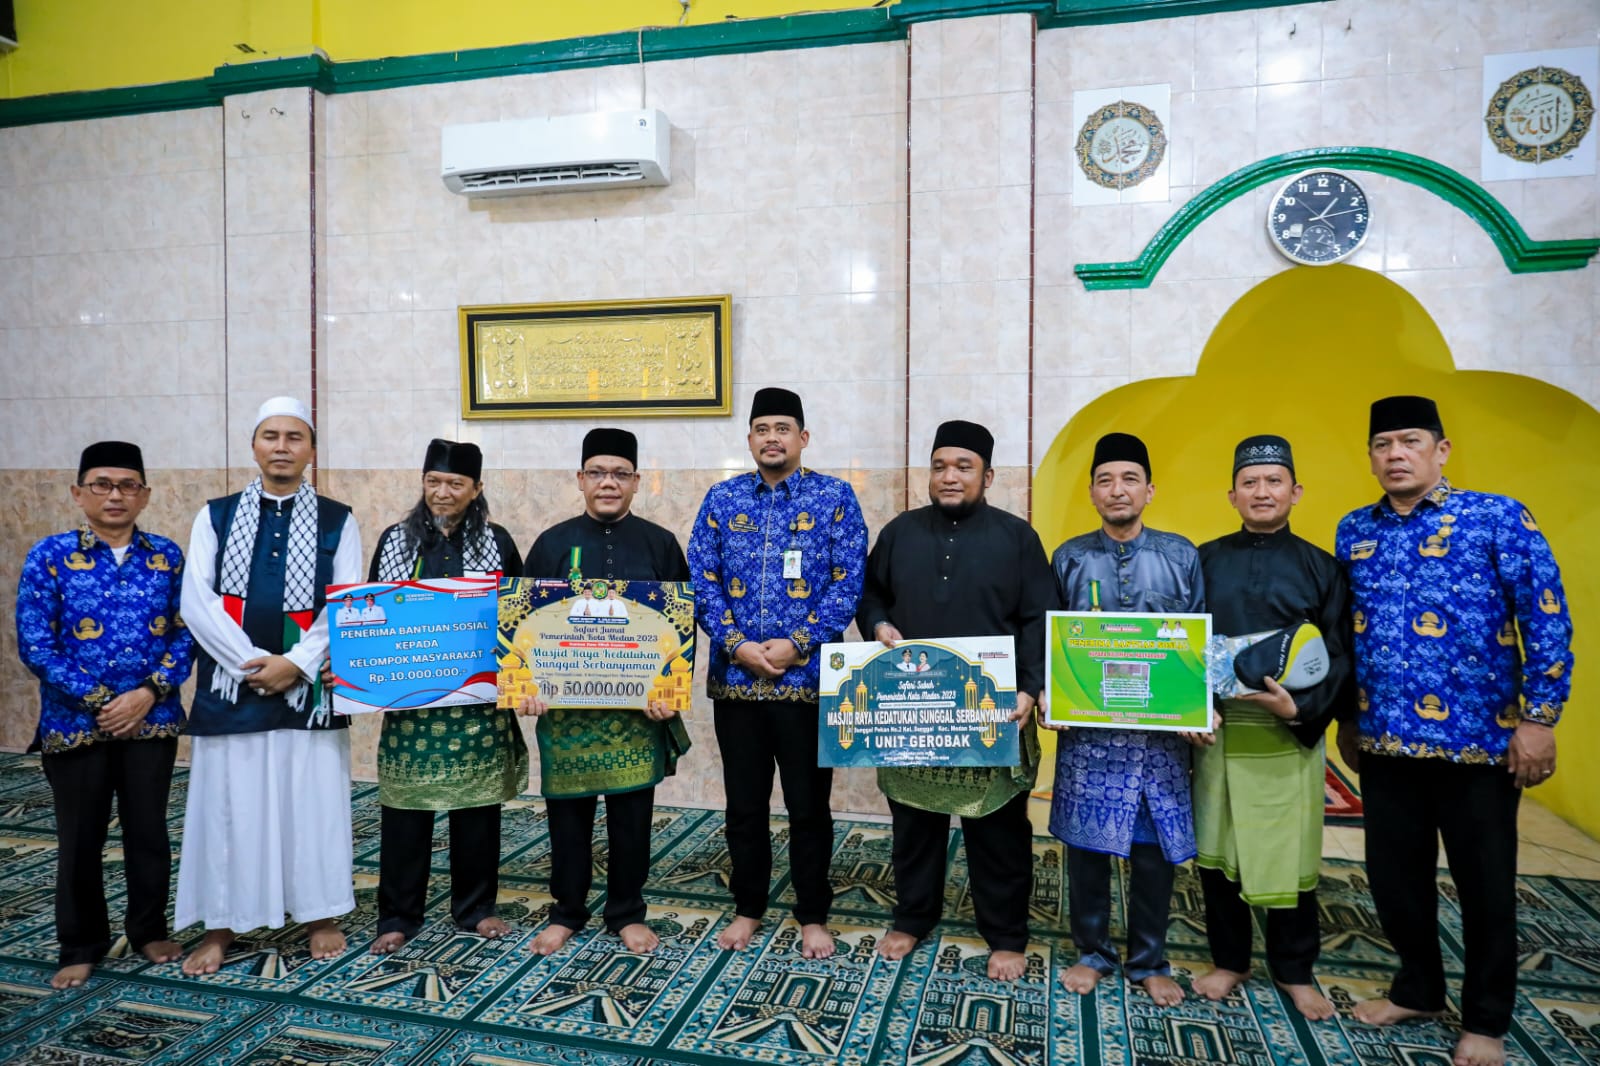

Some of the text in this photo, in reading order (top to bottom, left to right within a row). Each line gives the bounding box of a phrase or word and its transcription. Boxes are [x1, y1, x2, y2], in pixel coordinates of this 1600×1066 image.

[1317, 178, 1328, 187] 12
[1298, 184, 1308, 192] 11
[1339, 184, 1345, 192] 1
[1285, 197, 1295, 206] 10
[1350, 197, 1359, 206] 2
[1278, 213, 1286, 222] 9
[1354, 214, 1363, 223] 3
[1282, 230, 1290, 239] 8
[1347, 231, 1356, 239] 4
[1293, 244, 1302, 253] 7
[1333, 244, 1341, 253] 5
[340, 621, 489, 639] PENERIMA BANTUAN SOSIAL
[573, 626, 599, 635] Safari
[608, 634, 635, 642] Medan
[636, 634, 658, 642] 2023
[395, 639, 439, 650] KEPADA
[532, 648, 568, 660] Masjid
[571, 648, 600, 660] Raya
[349, 650, 483, 668] KELOMPOK MASYARAKAT
[535, 659, 656, 672] Sunggal Serbanyaman
[369, 673, 387, 685] Rp.
[541, 681, 645, 698] Rp 50.000.000
[827, 711, 853, 726] MASJID
[855, 711, 873, 725] RAYA
[874, 710, 917, 725] KEDATUKAN
[919, 709, 955, 724] SUNGGAL
[864, 734, 970, 748] 1 UNIT GEROBAK
